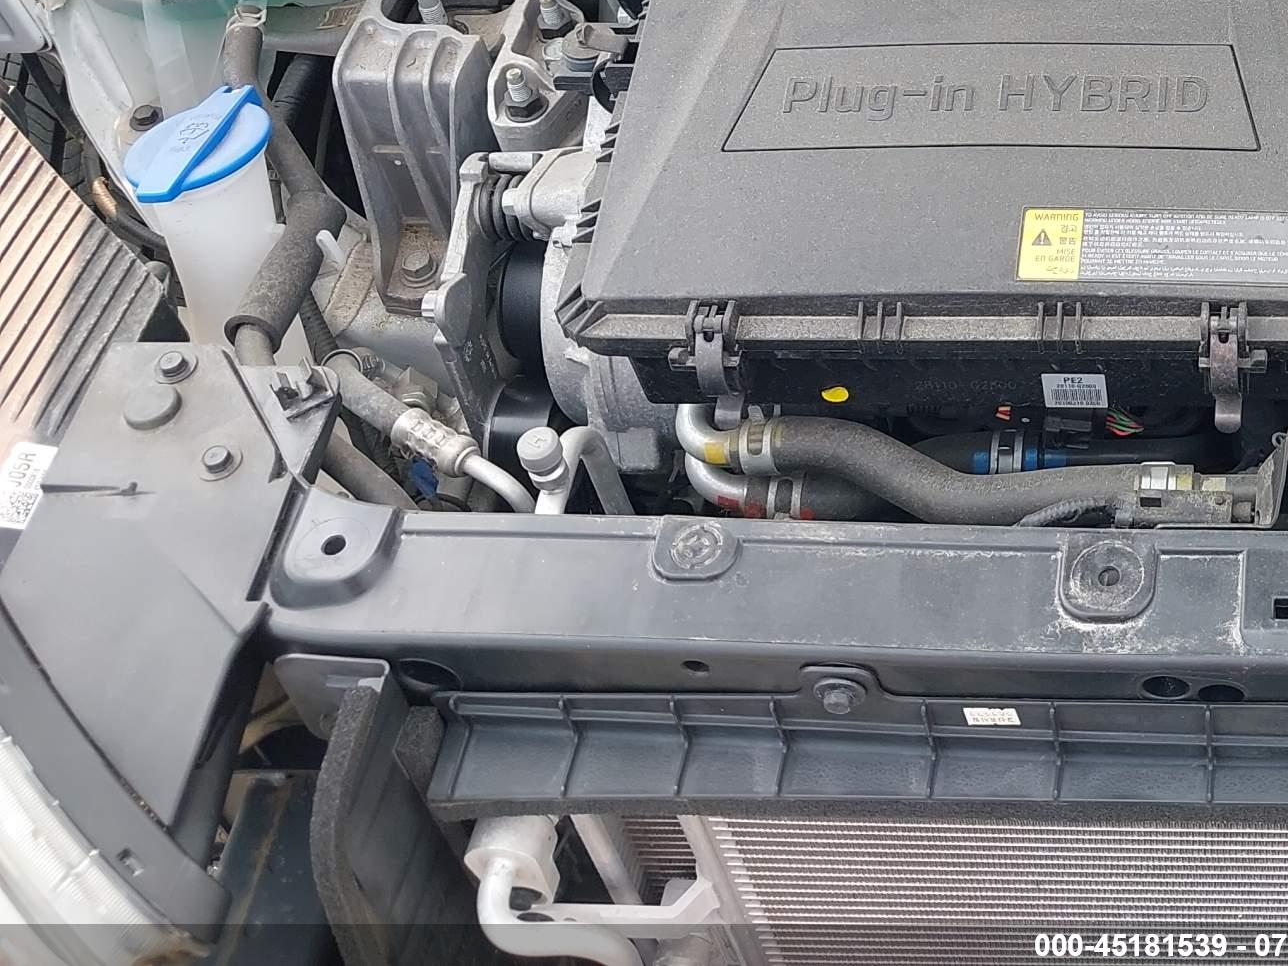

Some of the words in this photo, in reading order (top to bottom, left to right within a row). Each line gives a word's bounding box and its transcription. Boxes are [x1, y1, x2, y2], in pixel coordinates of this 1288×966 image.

[782, 74, 976, 122] Plug-in
[999, 74, 1209, 114] HYBRID
[1034, 213, 1079, 221] WARNING
[1063, 376, 1083, 384] PE2
